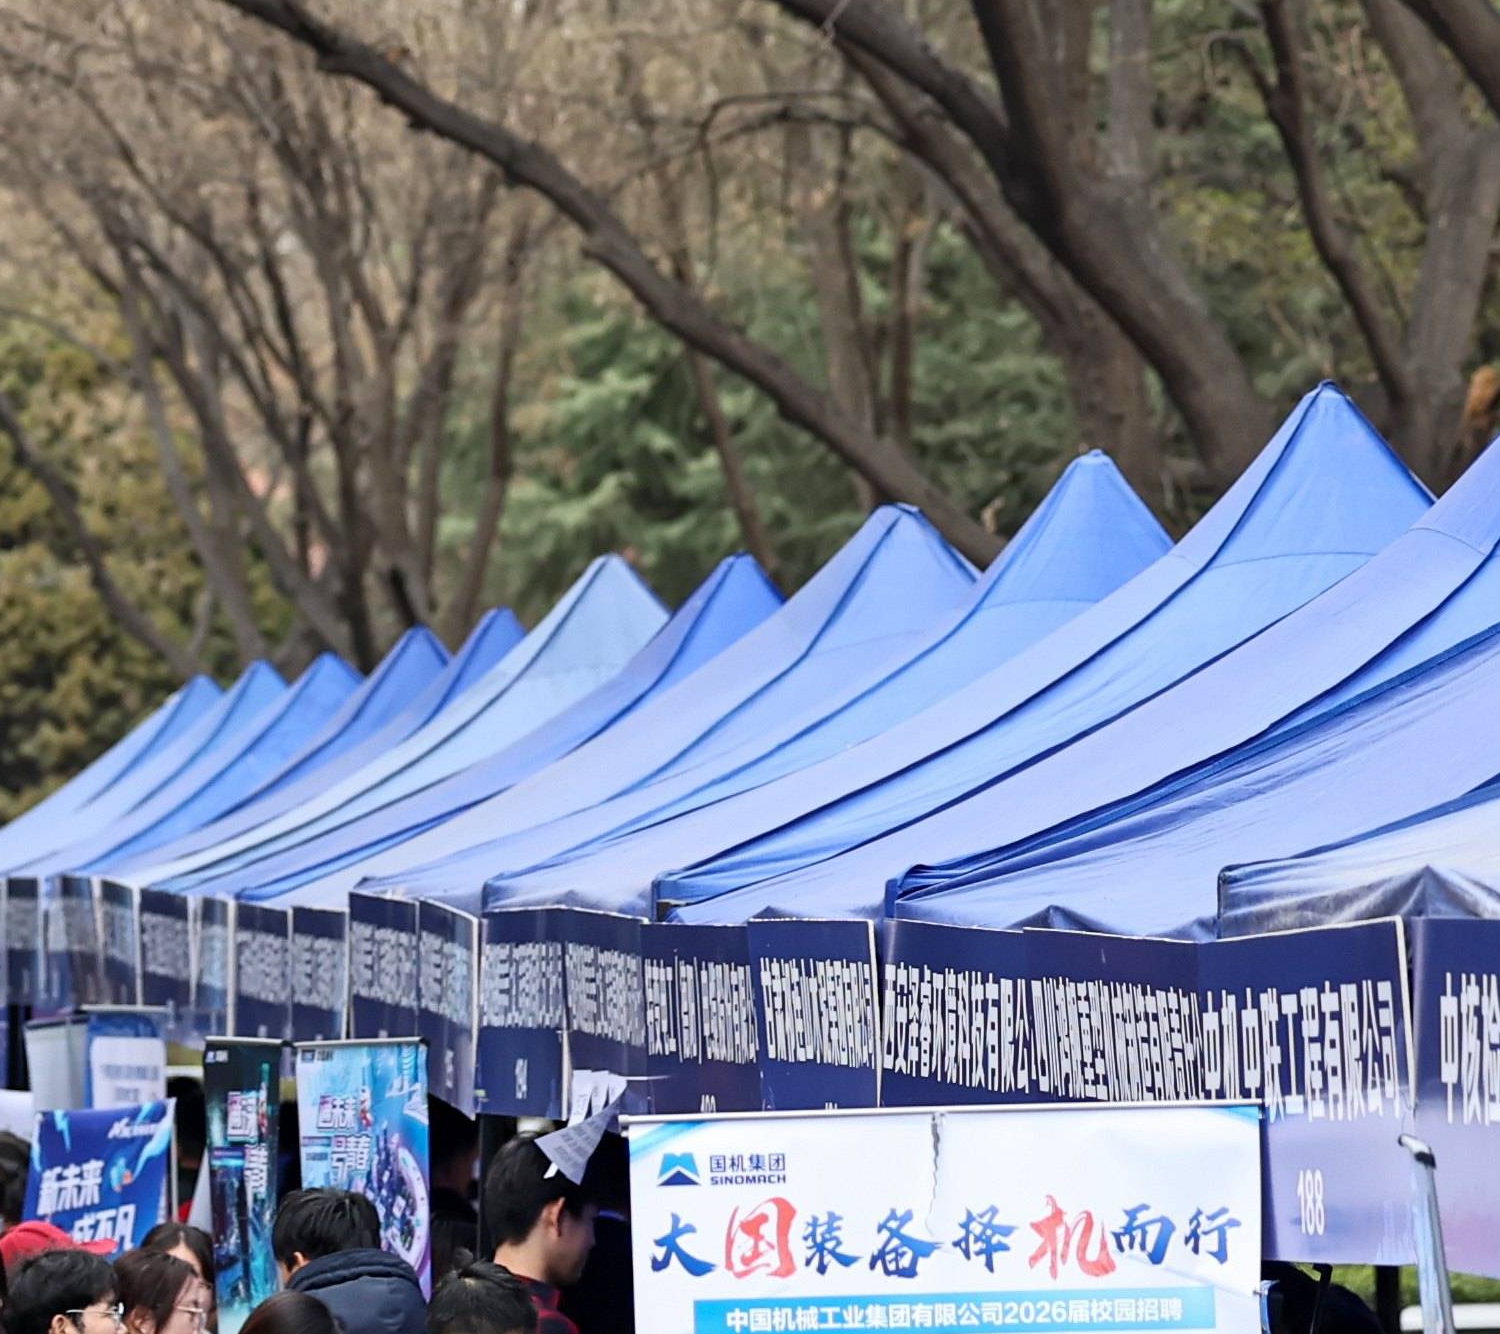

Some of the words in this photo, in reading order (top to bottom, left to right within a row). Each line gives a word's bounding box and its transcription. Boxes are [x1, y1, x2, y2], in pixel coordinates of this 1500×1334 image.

[883, 961, 1038, 1095] 西安泽睿环境科技有限公
[1201, 980, 1400, 1124] 中机中联工程有限公司
[709, 1153, 786, 1173] 国机集团
[709, 1174, 786, 1186] SINOMACH
[1298, 1169, 1325, 1236] 188
[650, 1194, 1242, 1282] 大国装备择机而行
[726, 1297, 1183, 1334] 中国机械工业集团有限公司2026届校园招聘
